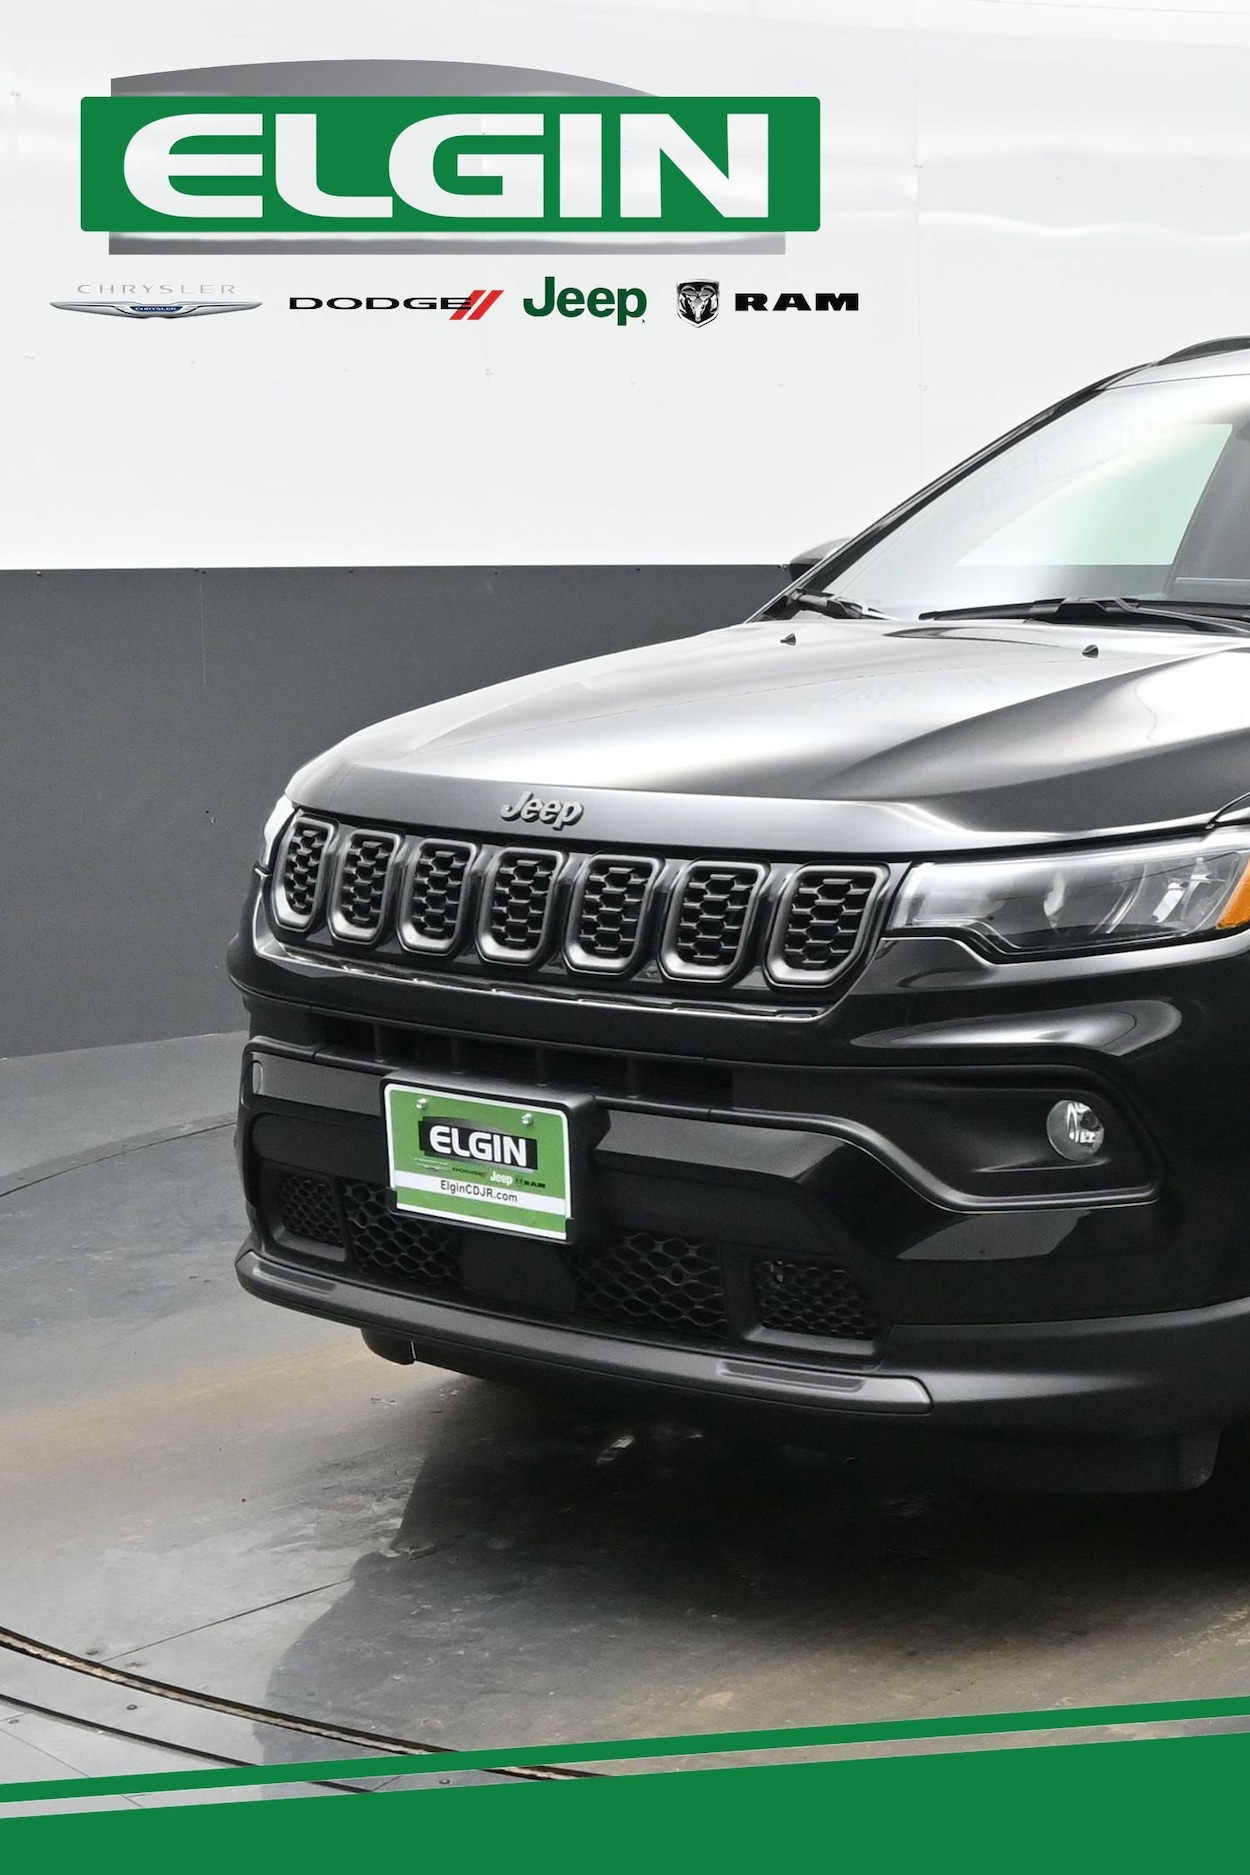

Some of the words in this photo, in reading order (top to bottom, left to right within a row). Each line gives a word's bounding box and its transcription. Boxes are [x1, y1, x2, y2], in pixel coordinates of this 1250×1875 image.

[500, 791, 584, 831] Jeep
[429, 1125, 527, 1167] ELGIN
[440, 1180, 518, 1203] ElginCDJR.com
[490, 1171, 513, 1186] Jeep
